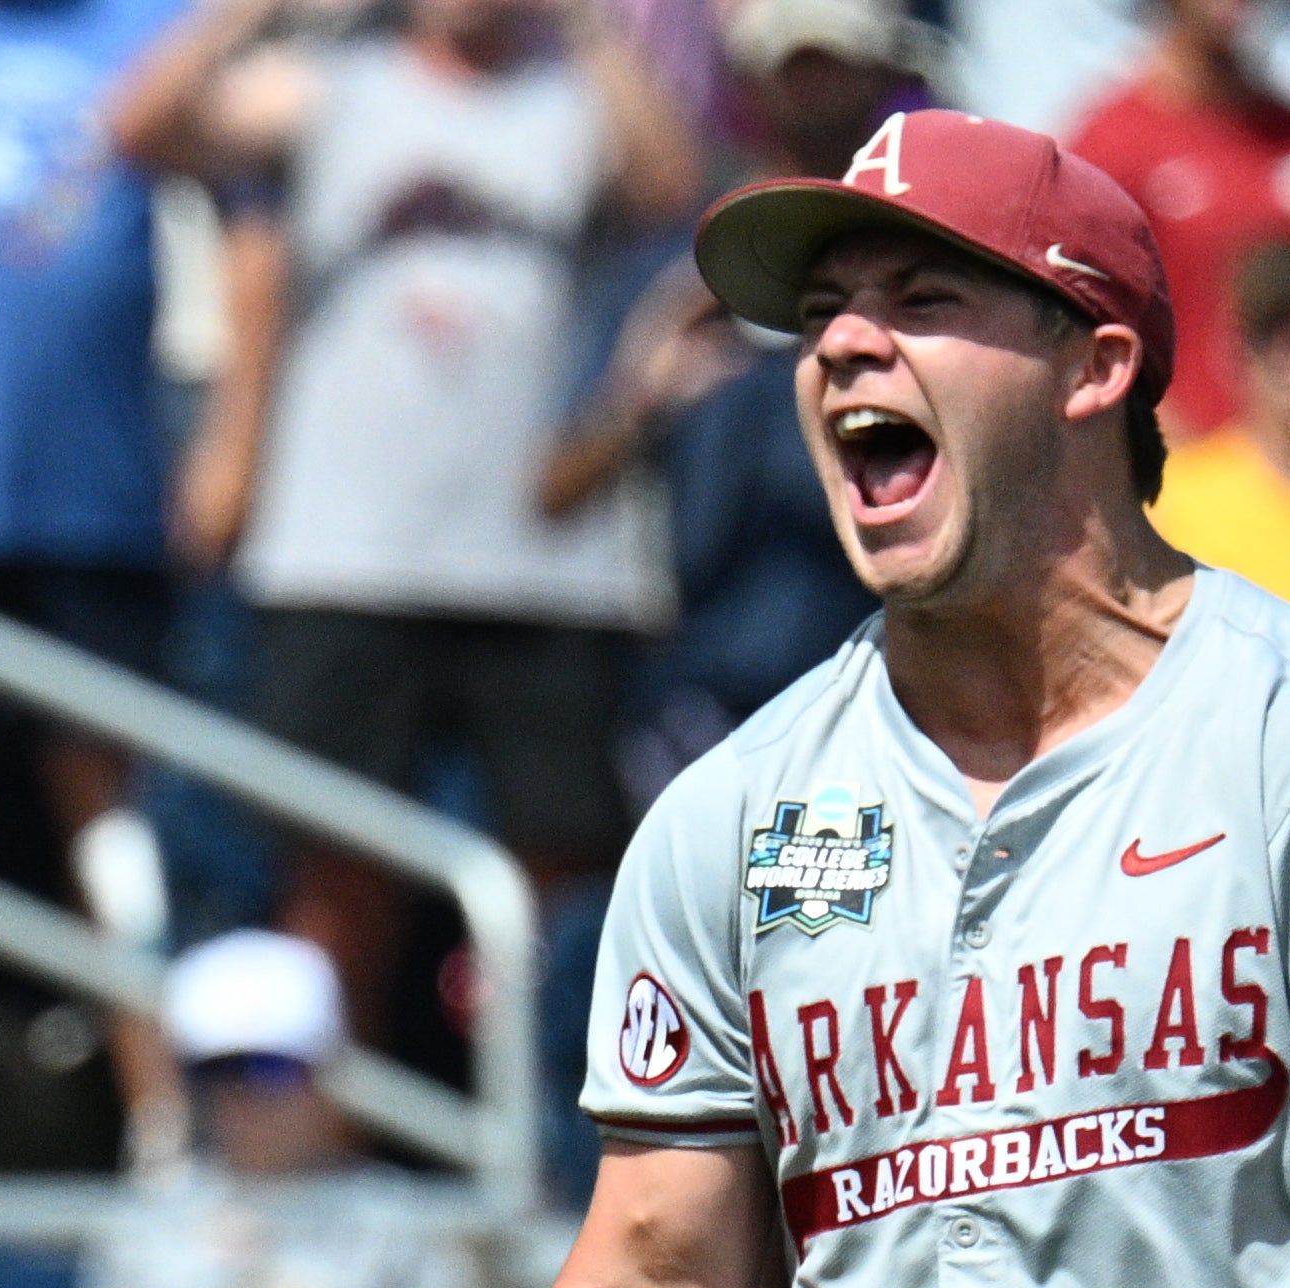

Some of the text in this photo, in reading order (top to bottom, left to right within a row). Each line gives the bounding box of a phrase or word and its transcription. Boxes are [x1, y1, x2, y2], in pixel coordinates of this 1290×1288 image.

[842, 111, 911, 195] A
[747, 864, 889, 890] WORLD SERIES
[778, 845, 869, 869] COLLEGE
[621, 978, 680, 1080] SEC
[748, 926, 1270, 1146] ARKANSAS
[832, 1107, 1166, 1222] RAZORBACKS
